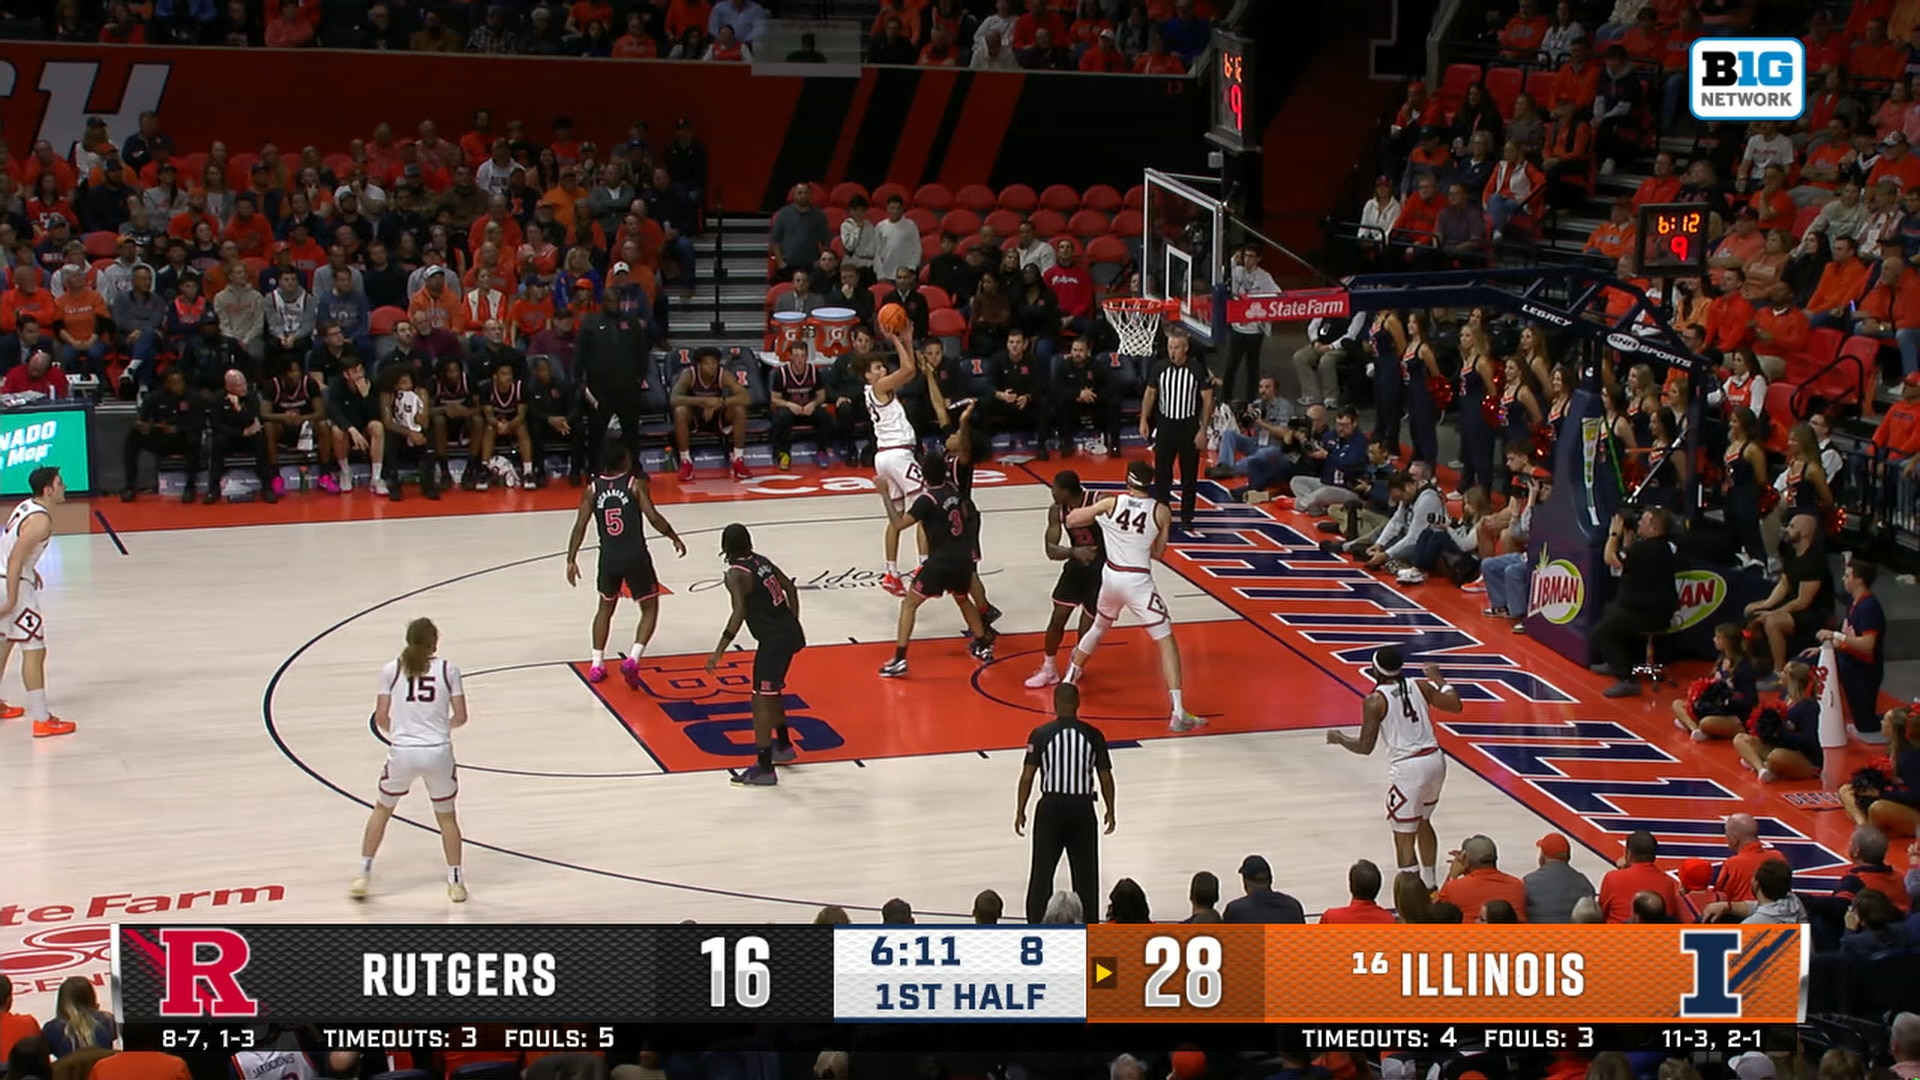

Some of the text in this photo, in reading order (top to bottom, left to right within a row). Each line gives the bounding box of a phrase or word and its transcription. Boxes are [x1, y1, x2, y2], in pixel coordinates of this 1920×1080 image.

[1671, 236, 1688, 261] 9
[1521, 303, 1573, 327] LEGACY
[1639, 345, 1693, 369] SPORTS
[7, 444, 49, 468] Map
[604, 508, 624, 536] 5
[949, 509, 963, 537] 3
[1116, 508, 1147, 534] 44
[1530, 571, 1580, 612] LIBMAN
[406, 676, 435, 702] 15
[87, 885, 285, 918] Farm
